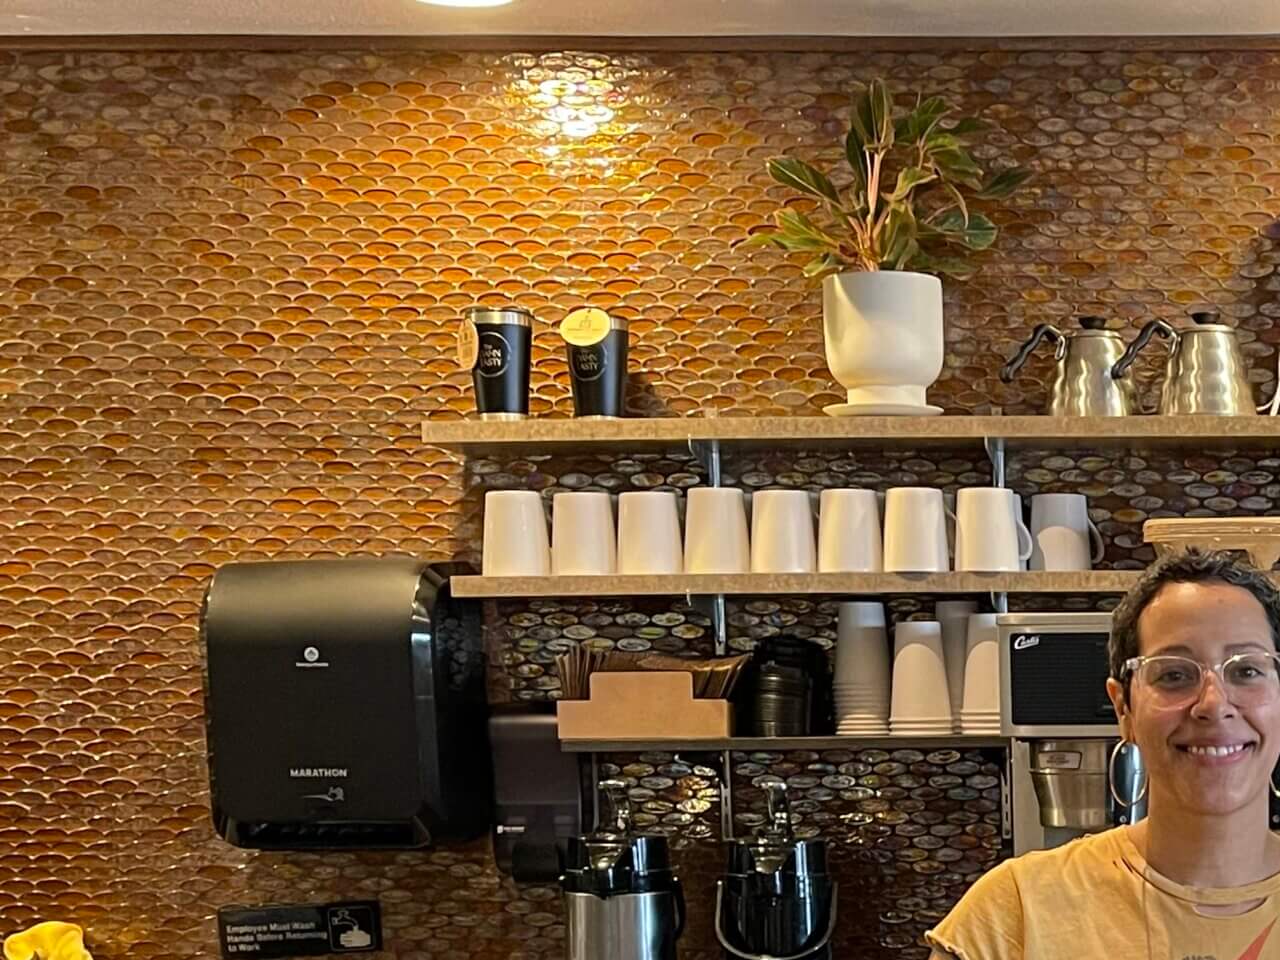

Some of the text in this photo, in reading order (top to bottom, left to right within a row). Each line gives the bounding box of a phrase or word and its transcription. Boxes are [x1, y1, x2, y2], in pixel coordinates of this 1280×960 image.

[290, 768, 348, 777] MARATHON
[226, 921, 316, 935] Employee Must Wash
[227, 933, 255, 943] Hands
[256, 932, 284, 942] Before
[228, 942, 261, 952] to Work
